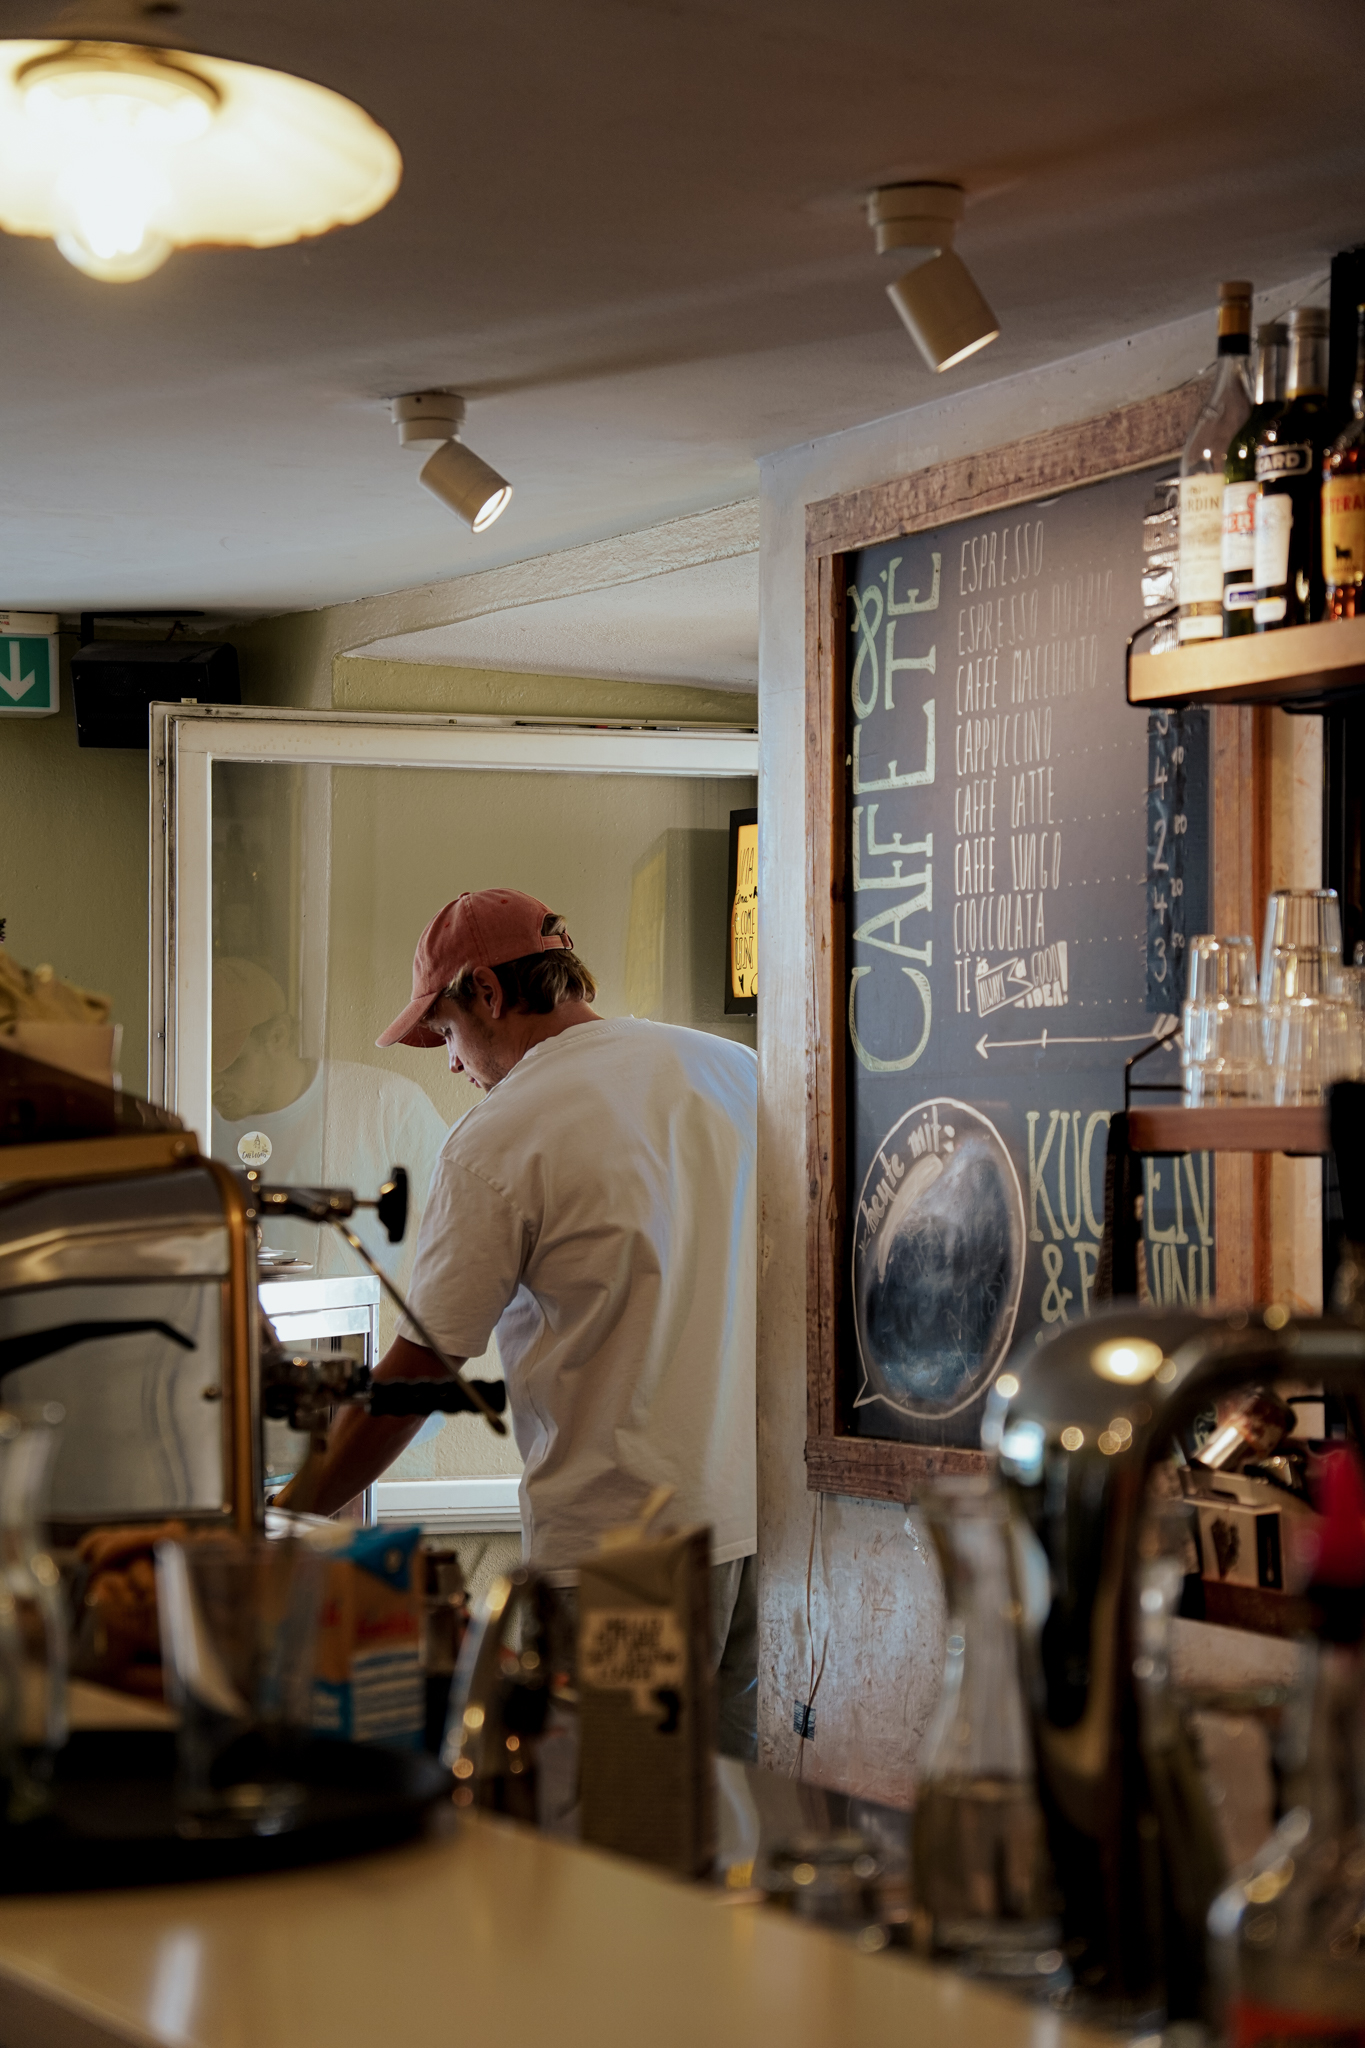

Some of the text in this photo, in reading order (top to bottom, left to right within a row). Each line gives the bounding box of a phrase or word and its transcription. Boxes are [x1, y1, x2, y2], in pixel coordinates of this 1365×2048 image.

[960, 520, 1044, 596] ESPRESSO
[847, 584, 884, 720] &
[958, 588, 1039, 656] ESPRESSO
[1011, 634, 1098, 704] MACCHIATO
[956, 706, 1052, 777] CAPPUCCINO
[1010, 766, 1055, 829] LATTE
[954, 831, 1062, 897] CAFFE LUNGO
[953, 892, 1046, 955] CIOCCOLATA
[1031, 944, 1061, 987] GOOD
[860, 1150, 905, 1235] heute
[1026, 1109, 1214, 1247] KUCEN
